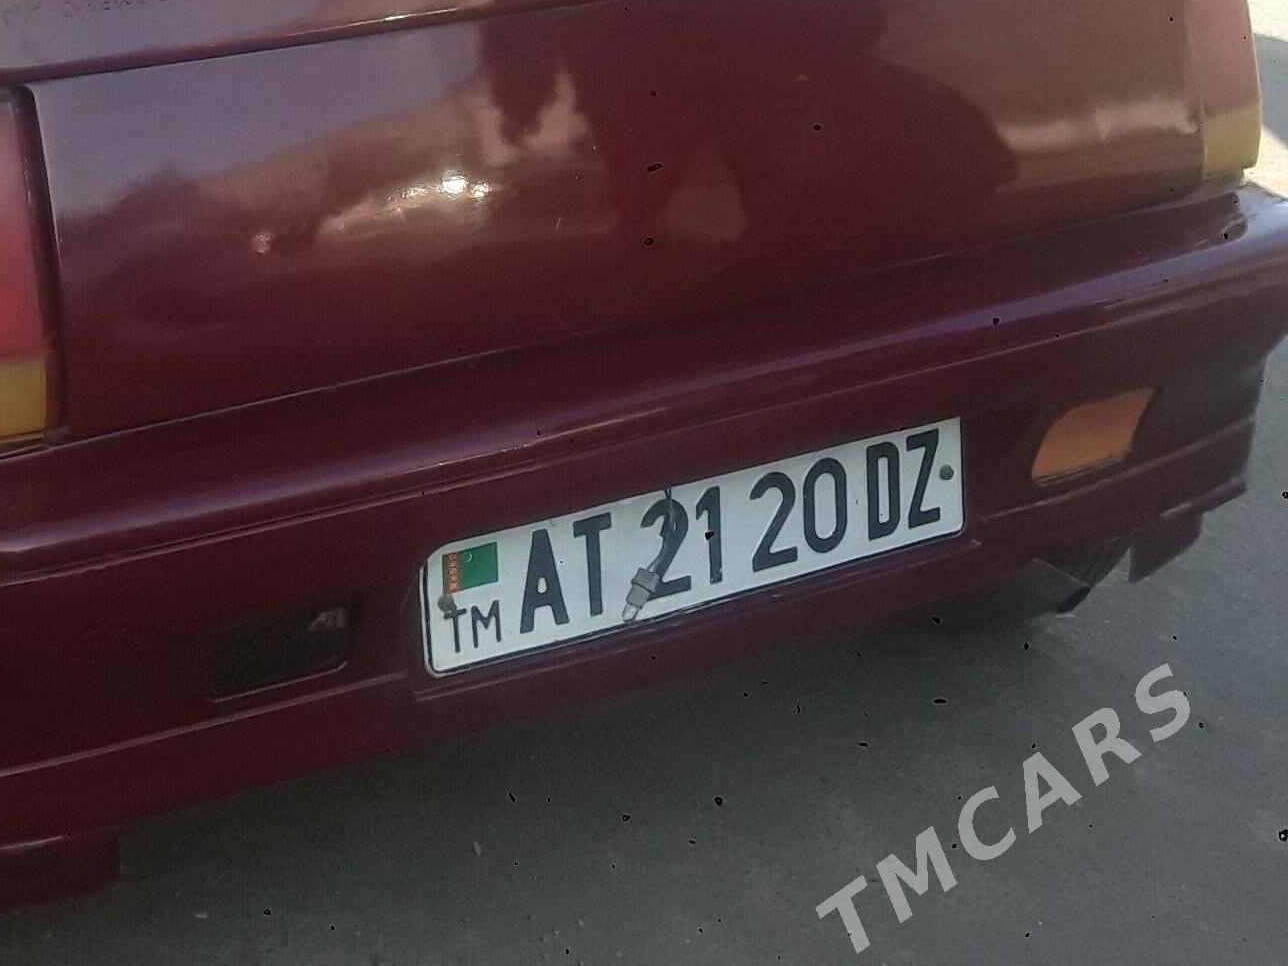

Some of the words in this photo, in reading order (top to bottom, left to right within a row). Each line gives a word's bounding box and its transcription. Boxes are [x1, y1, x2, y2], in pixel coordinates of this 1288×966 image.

[519, 512, 612, 634] AT
[640, 485, 722, 602] 21
[749, 456, 848, 573] 20
[866, 427, 942, 541] DZ
[443, 599, 503, 654] TM
